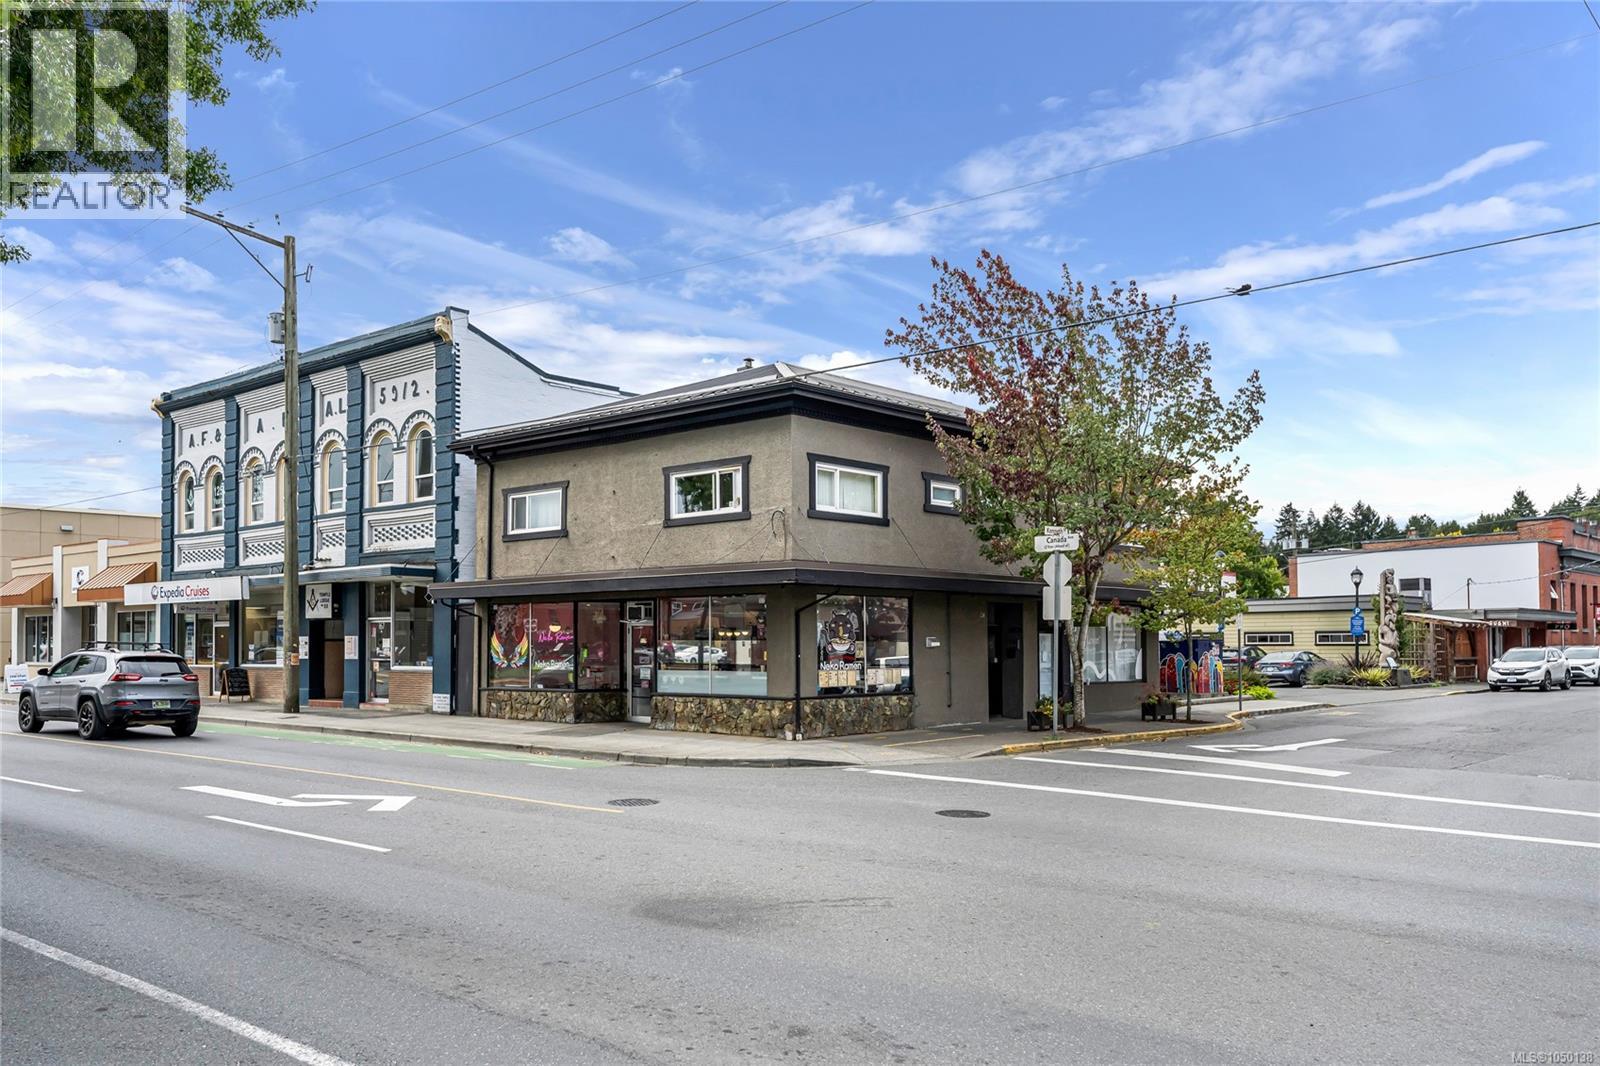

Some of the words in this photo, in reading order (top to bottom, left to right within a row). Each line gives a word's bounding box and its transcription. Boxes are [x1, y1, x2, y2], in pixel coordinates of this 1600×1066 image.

[159, 586, 184, 601] Expedia
[185, 585, 209, 597] Cruises
[820, 661, 839, 671] Neko
[839, 661, 862, 670] Ramen
